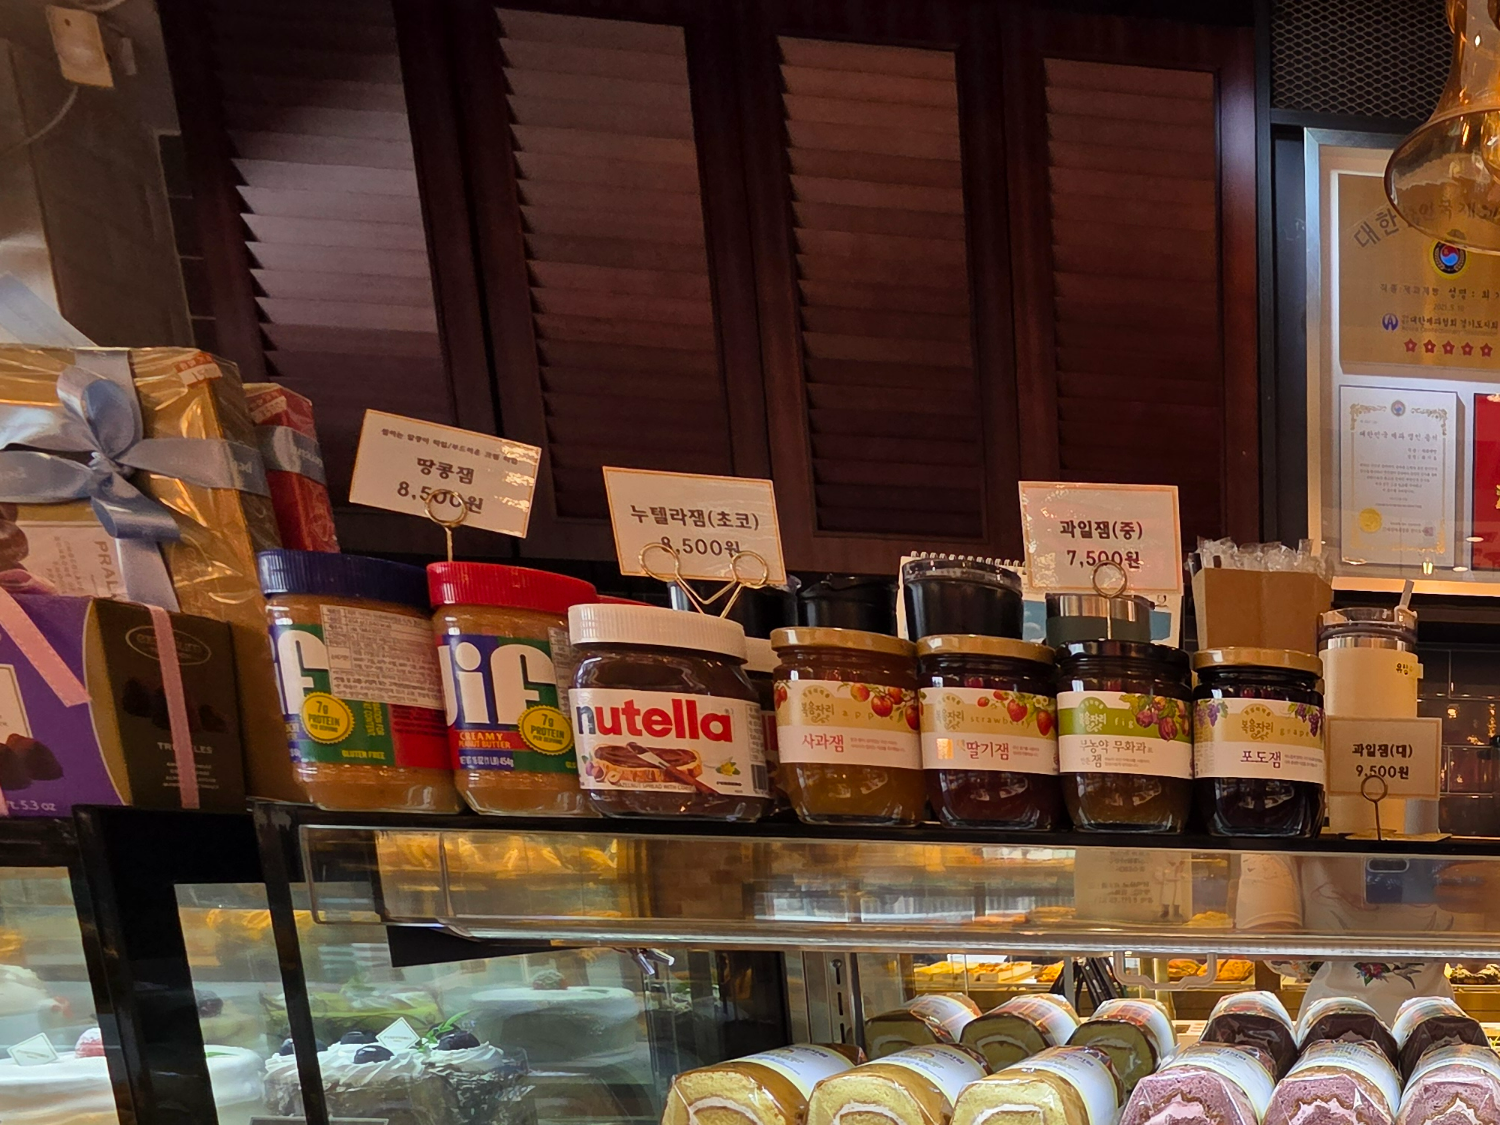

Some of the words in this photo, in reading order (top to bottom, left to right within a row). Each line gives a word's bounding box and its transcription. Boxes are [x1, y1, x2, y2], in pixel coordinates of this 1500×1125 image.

[417, 457, 474, 485] 땅콩잼
[397, 481, 483, 514] 8,500원
[630, 504, 760, 531] 누텔라잼(초코)
[1060, 520, 1143, 540] 과일잼(중)
[661, 536, 741, 558] 8,500원
[1067, 550, 1140, 569] 7,500원
[316, 701, 328, 714] 7g
[308, 713, 340, 727] PROTEIN
[541, 713, 554, 727] 7g
[576, 698, 733, 743] nutella
[1114, 716, 1134, 729] fig
[1241, 719, 1274, 734] 복음자리
[460, 732, 503, 741] CREAMY
[530, 725, 564, 739] PROTEIN
[802, 733, 844, 753] 사과잼
[966, 740, 1010, 761] 딸기잼
[1352, 743, 1413, 759] 과일잼(대)
[1240, 750, 1281, 769] 포도잼
[1356, 764, 1409, 780] 9,500원
